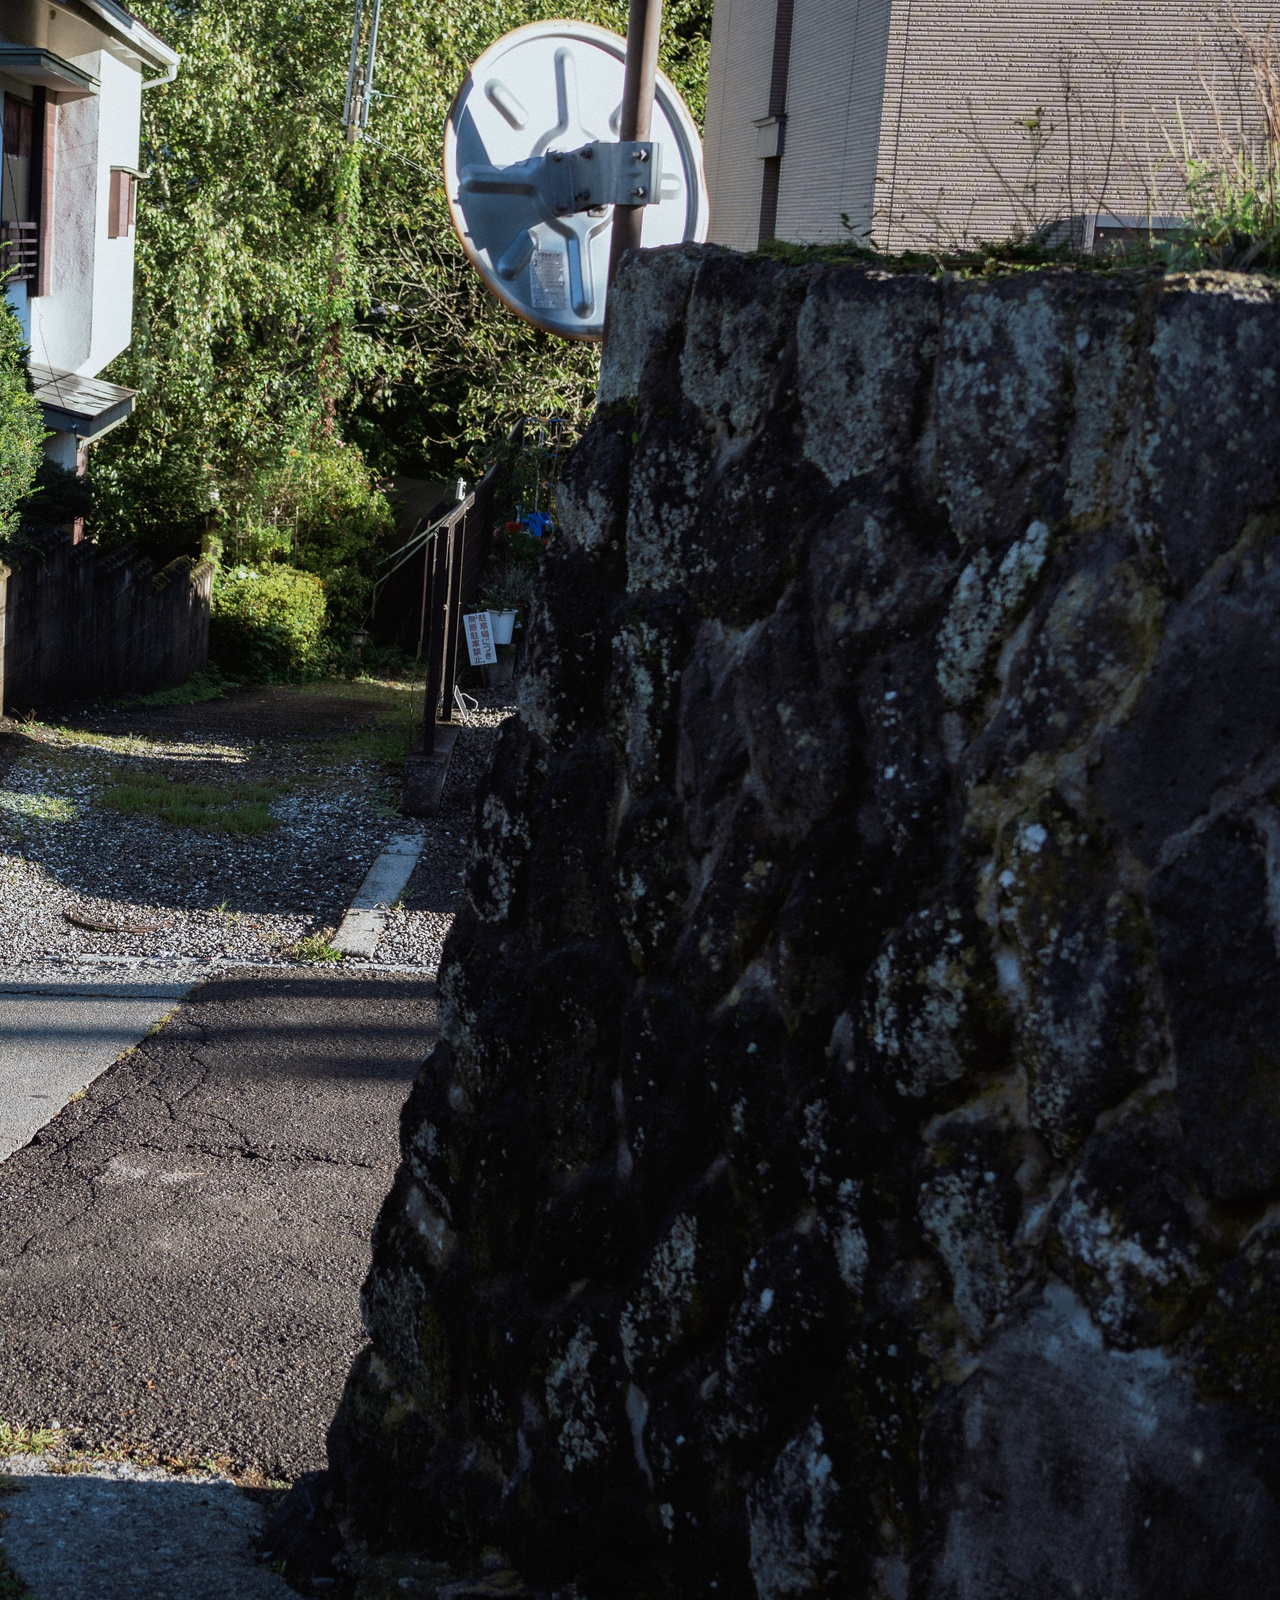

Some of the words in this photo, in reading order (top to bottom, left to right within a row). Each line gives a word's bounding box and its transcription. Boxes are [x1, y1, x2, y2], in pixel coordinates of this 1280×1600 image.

[477, 613, 492, 660] 駐車場につき
